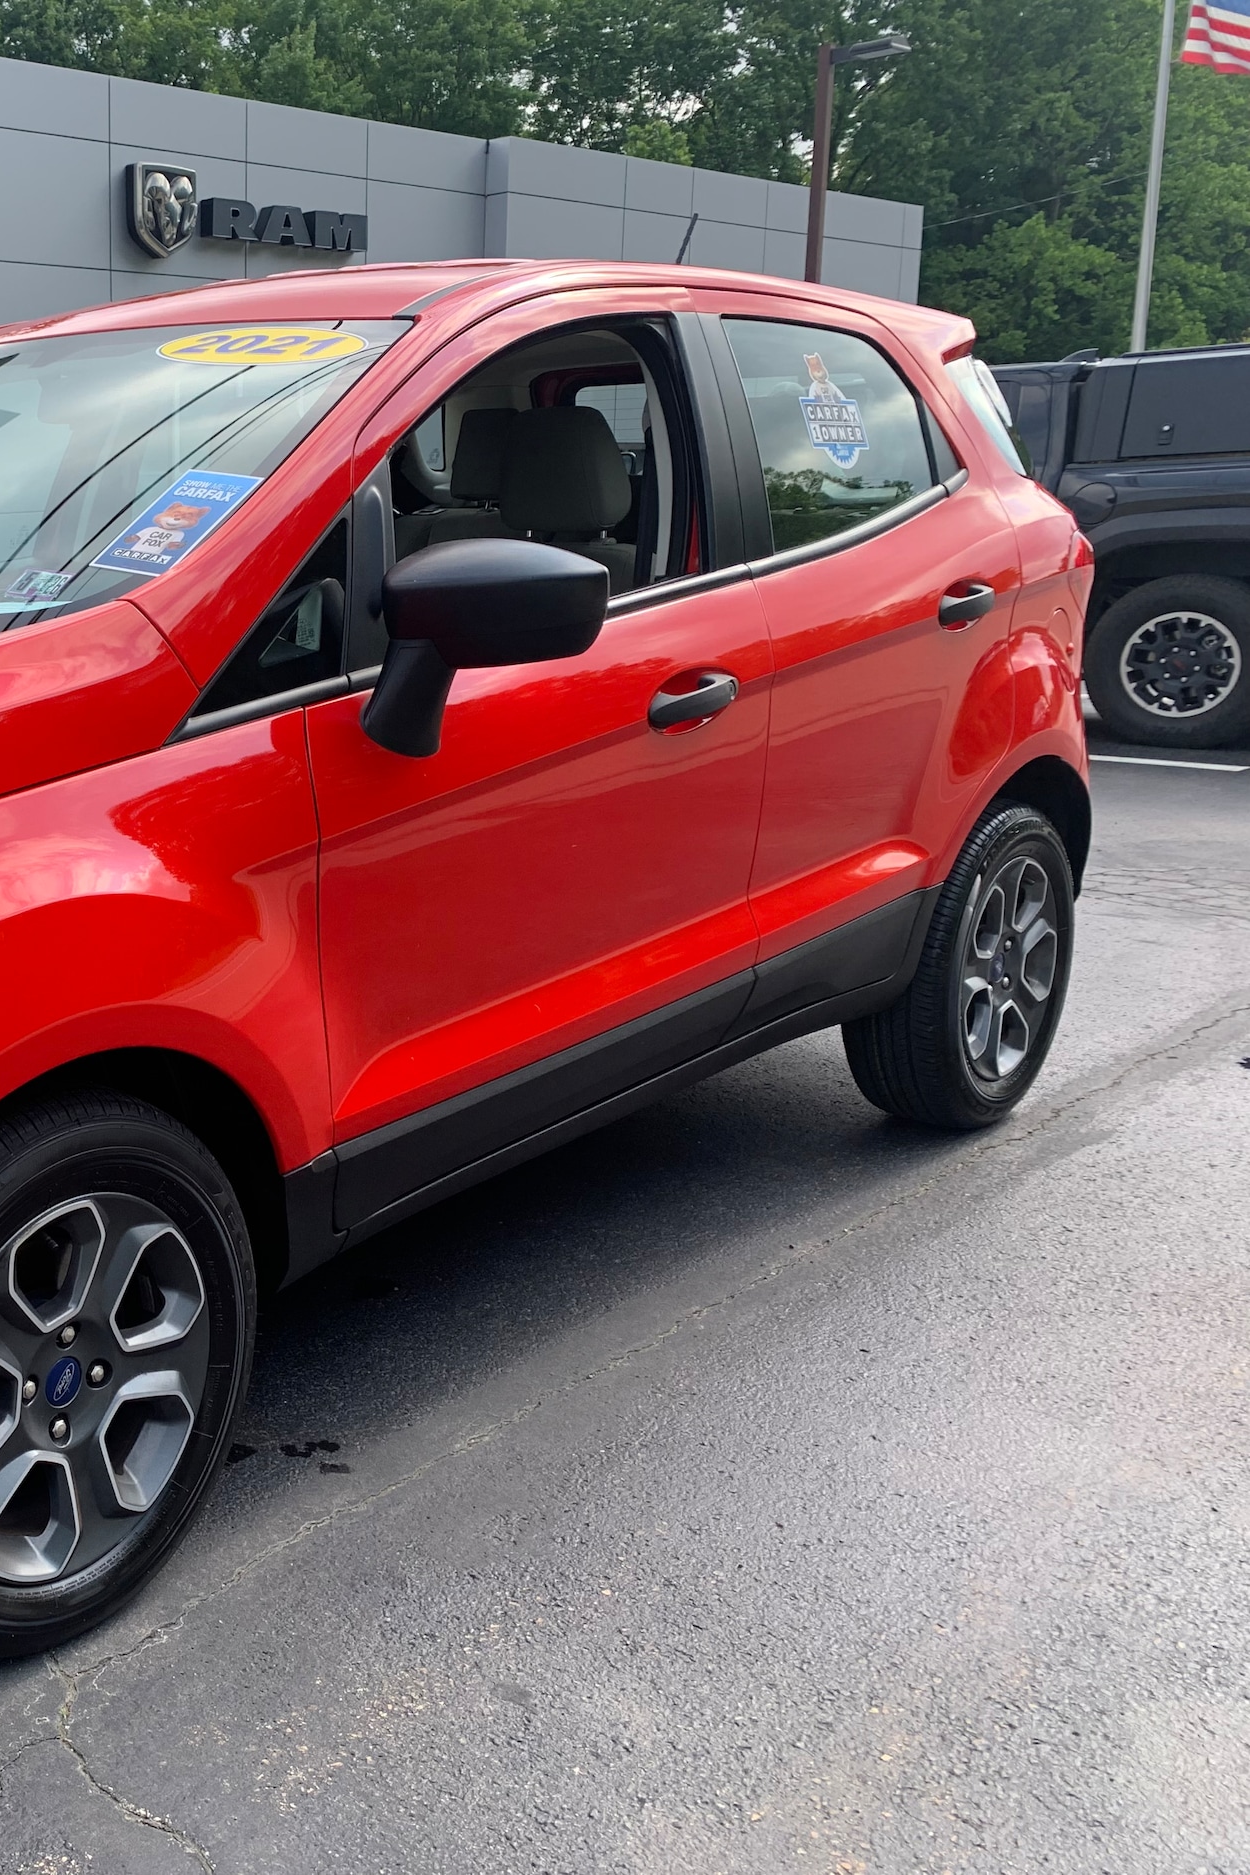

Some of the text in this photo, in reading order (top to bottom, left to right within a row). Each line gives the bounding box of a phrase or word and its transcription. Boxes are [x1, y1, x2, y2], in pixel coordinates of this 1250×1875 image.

[199, 197, 368, 252] RAM
[177, 332, 347, 357] 2021
[807, 406, 859, 423] CARFAX
[813, 426, 863, 440] 1 OWNER
[182, 479, 212, 489] SHOW
[226, 484, 243, 493] THE
[173, 486, 237, 503] CARFAX
[141, 539, 167, 548] FOX
[149, 531, 172, 541] CAR
[113, 549, 169, 565] CARFAX
